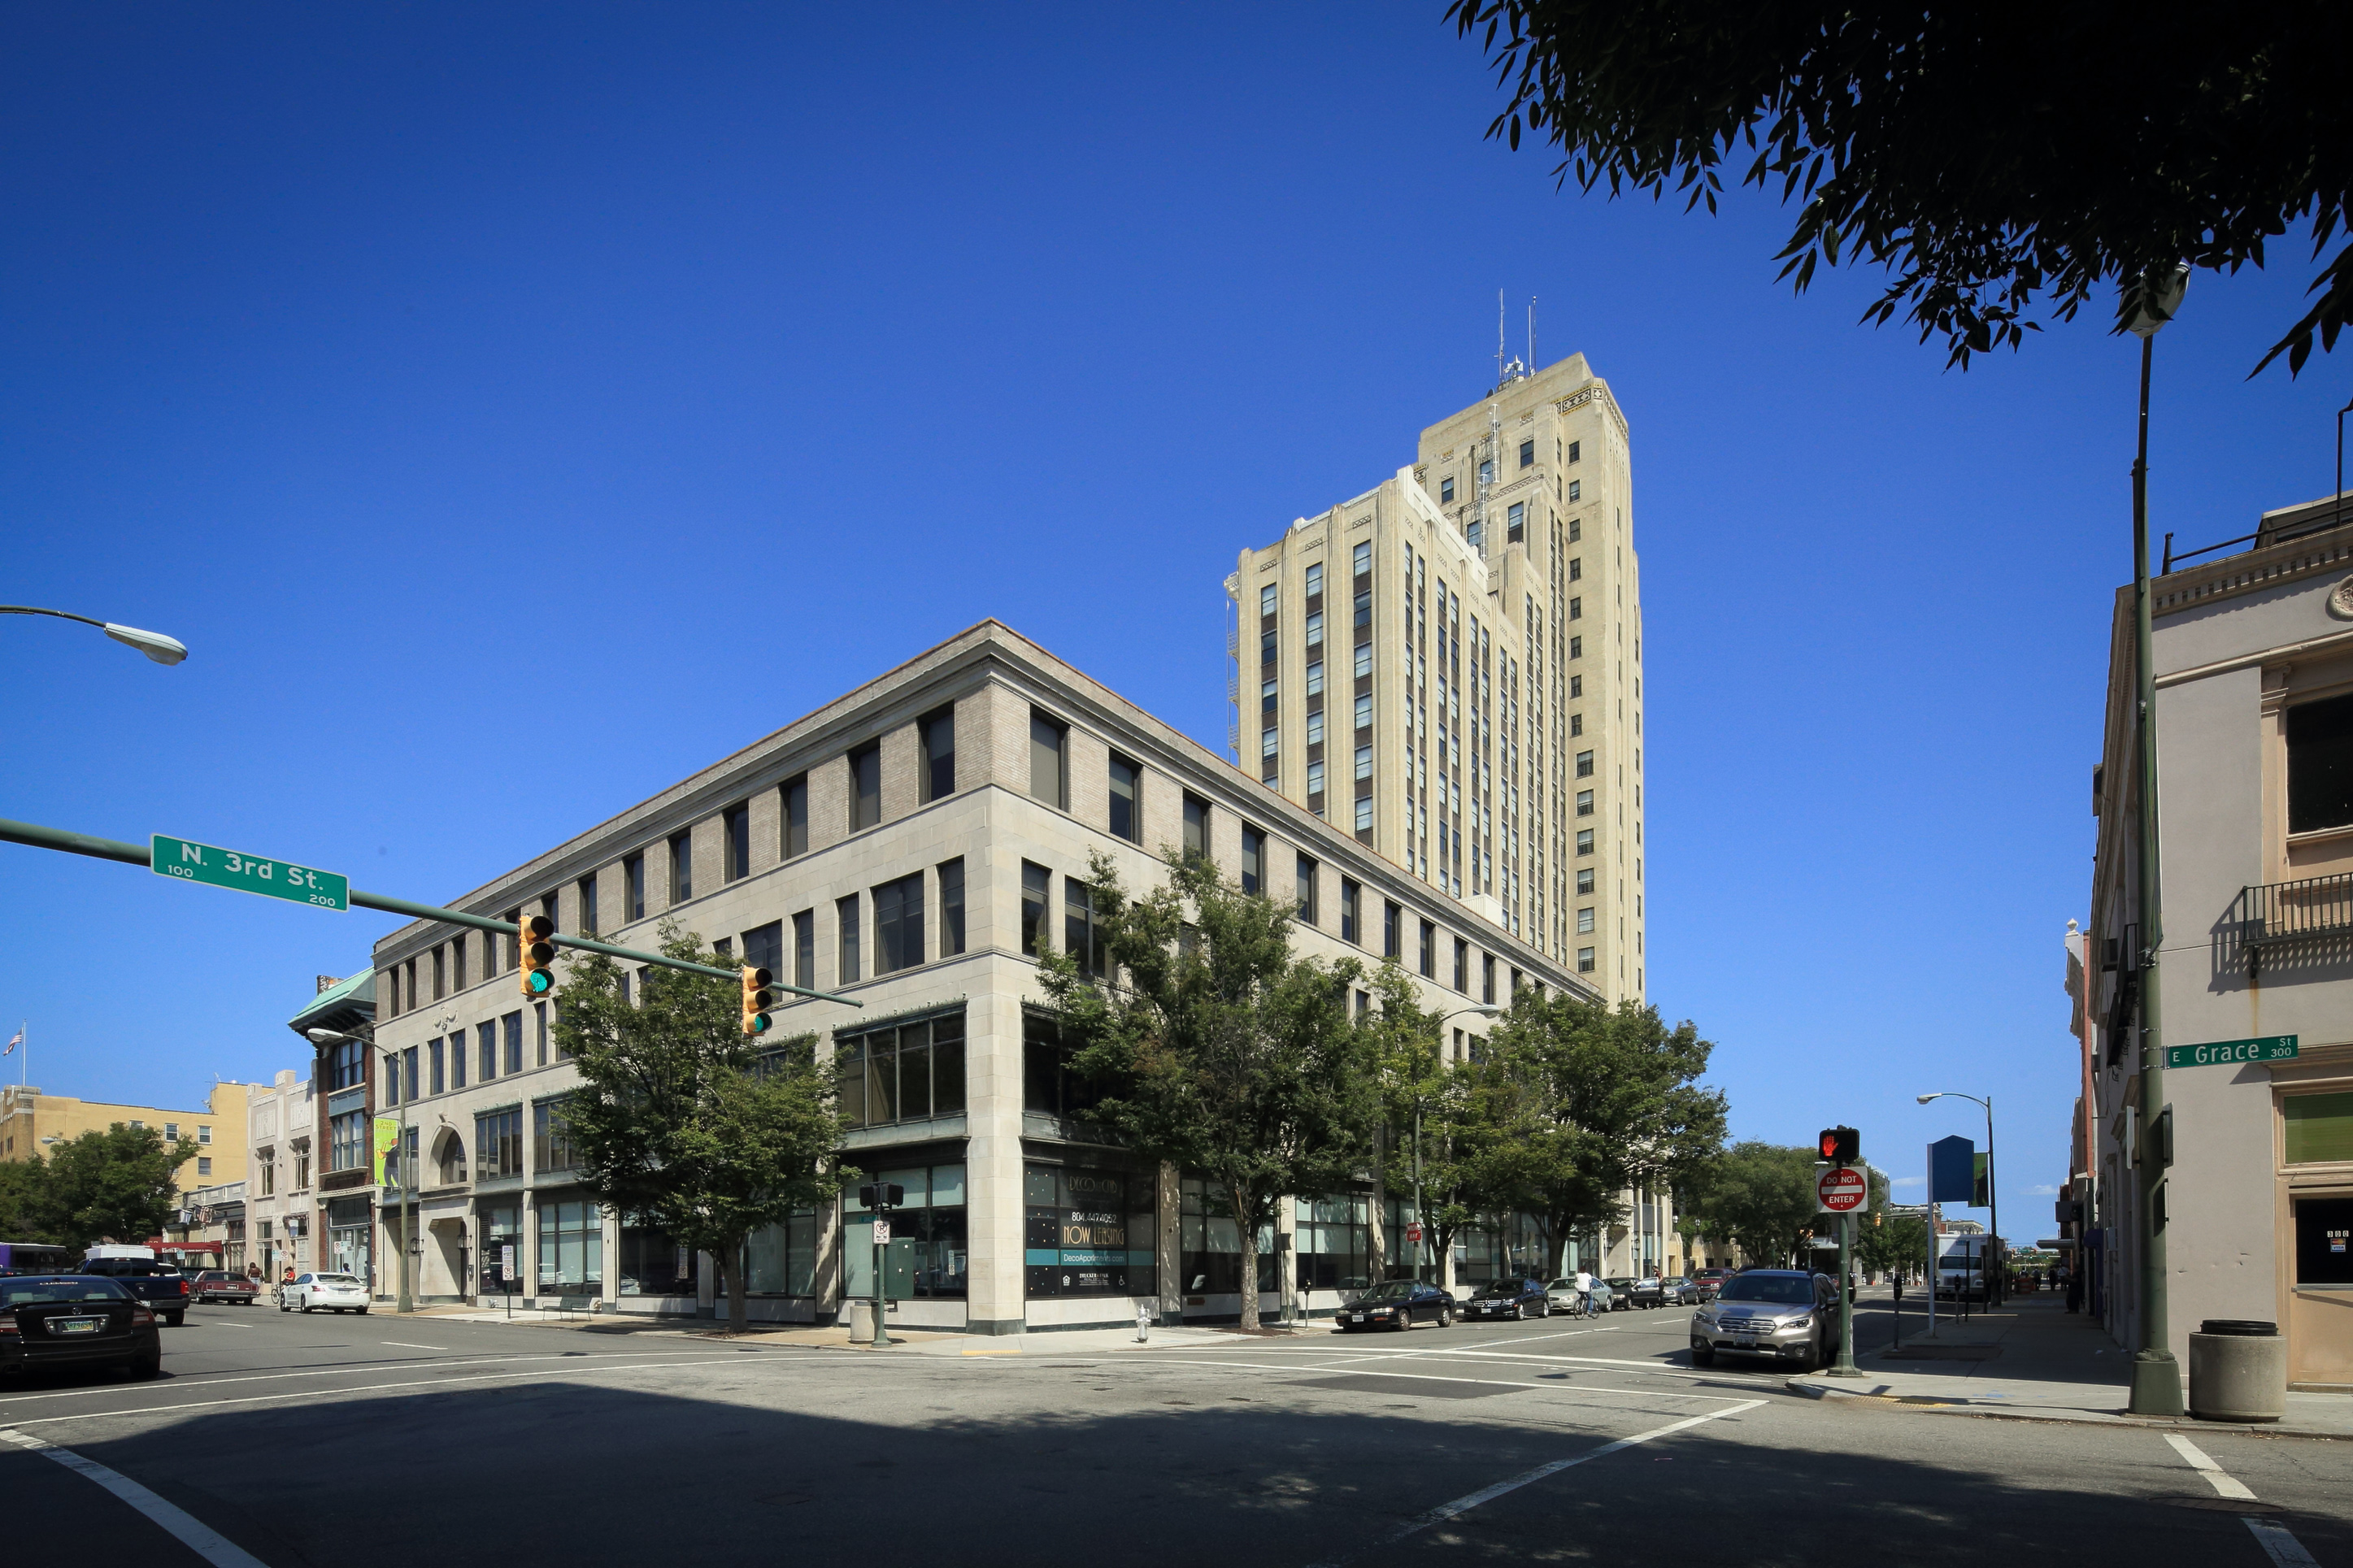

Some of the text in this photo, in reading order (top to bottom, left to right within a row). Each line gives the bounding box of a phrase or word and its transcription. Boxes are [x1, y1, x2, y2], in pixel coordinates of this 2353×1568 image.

[167, 864, 194, 878] 100
[181, 843, 324, 890] N. 3rd St.
[309, 894, 336, 907] 200
[2279, 1037, 2291, 1047] St
[2173, 1044, 2292, 1064] E Grace 300
[1069, 1175, 1095, 1192] DECO
[1841, 1175, 1857, 1184] NOT
[1829, 1195, 1855, 1204] ENTER
[1063, 1225, 1124, 1245] NOW LEASING
[1063, 1253, 1124, 1263] DecoApartments.com
